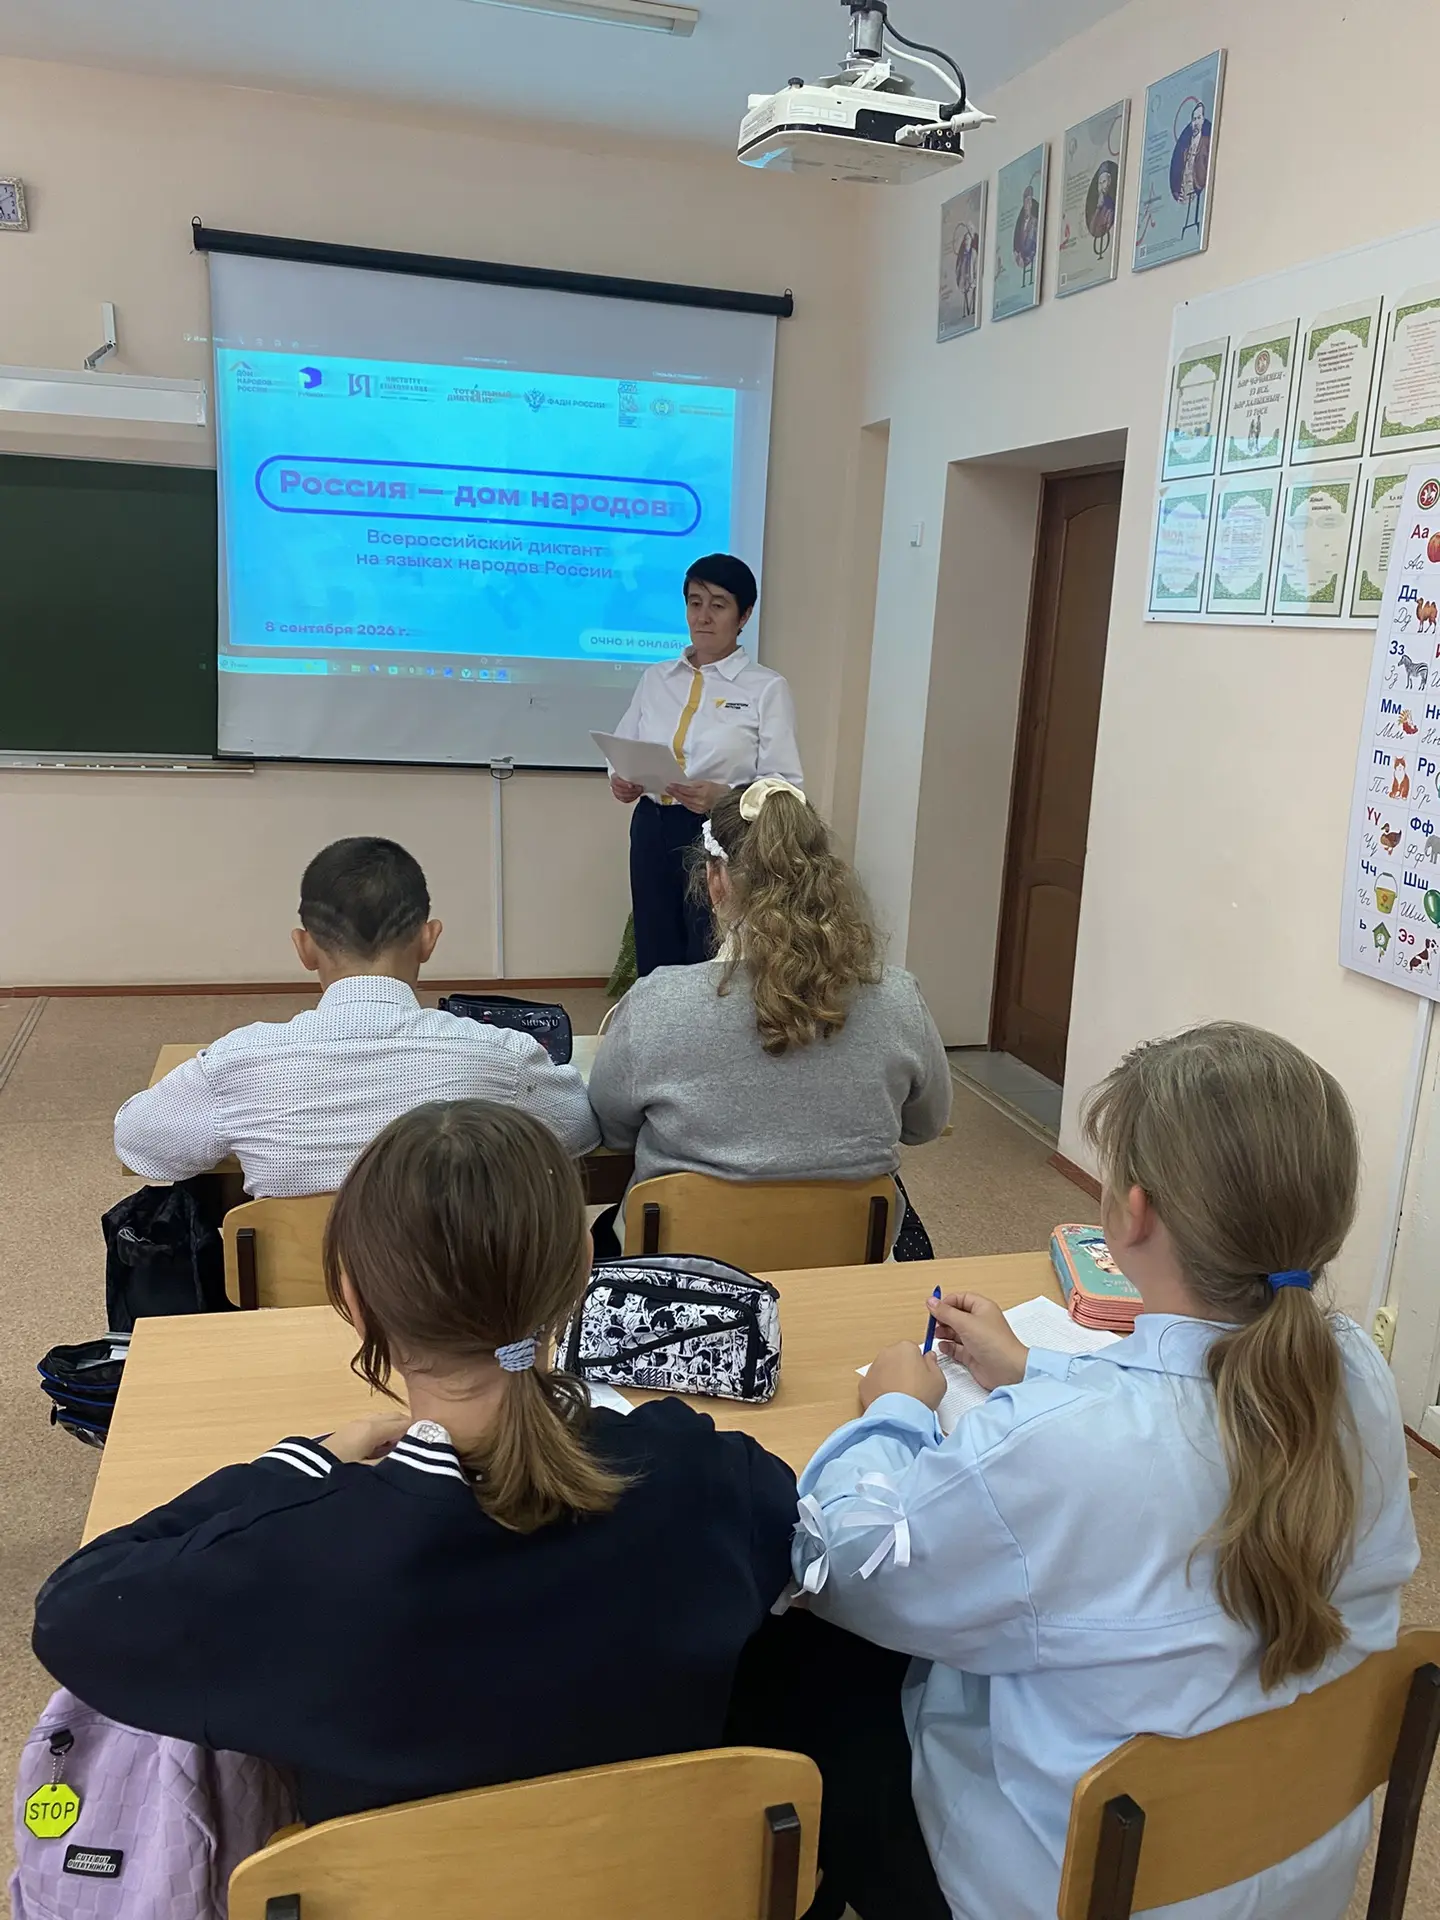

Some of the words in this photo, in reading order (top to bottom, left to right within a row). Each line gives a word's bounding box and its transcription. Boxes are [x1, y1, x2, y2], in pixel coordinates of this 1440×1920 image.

[280, 470, 406, 499] Россия
[455, 485, 520, 508] дом
[531, 490, 669, 519] народов
[1410, 523, 1430, 539] Аа
[367, 529, 523, 552] Всероссийский
[528, 541, 603, 557] диктант
[356, 553, 380, 566] на
[385, 555, 453, 569] языках
[459, 559, 539, 576] народов
[545, 560, 613, 579] России
[1404, 553, 1424, 570] Аа
[1397, 585, 1418, 603] Дд
[264, 622, 275, 632] 8
[279, 623, 351, 637] сентября
[357, 624, 395, 637] 2026
[590, 636, 623, 646] очно
[626, 637, 634, 647] и
[1389, 640, 1405, 656] Зз
[1380, 698, 1402, 715] Мм
[1375, 721, 1404, 740] Мм
[1373, 749, 1391, 766] Пп
[1417, 756, 1436, 777] Рр
[1368, 776, 1390, 795] Пп
[1412, 784, 1431, 809] Рр
[1410, 816, 1434, 838] Фф
[1404, 843, 1426, 869] Фф
[1361, 859, 1378, 877] Чч
[1403, 870, 1429, 891] Шш
[1400, 901, 1427, 923] Шш
[1397, 928, 1415, 946] Ээ
[521, 1019, 559, 1027] SHUNYU
[29, 1801, 75, 1820] STOP
